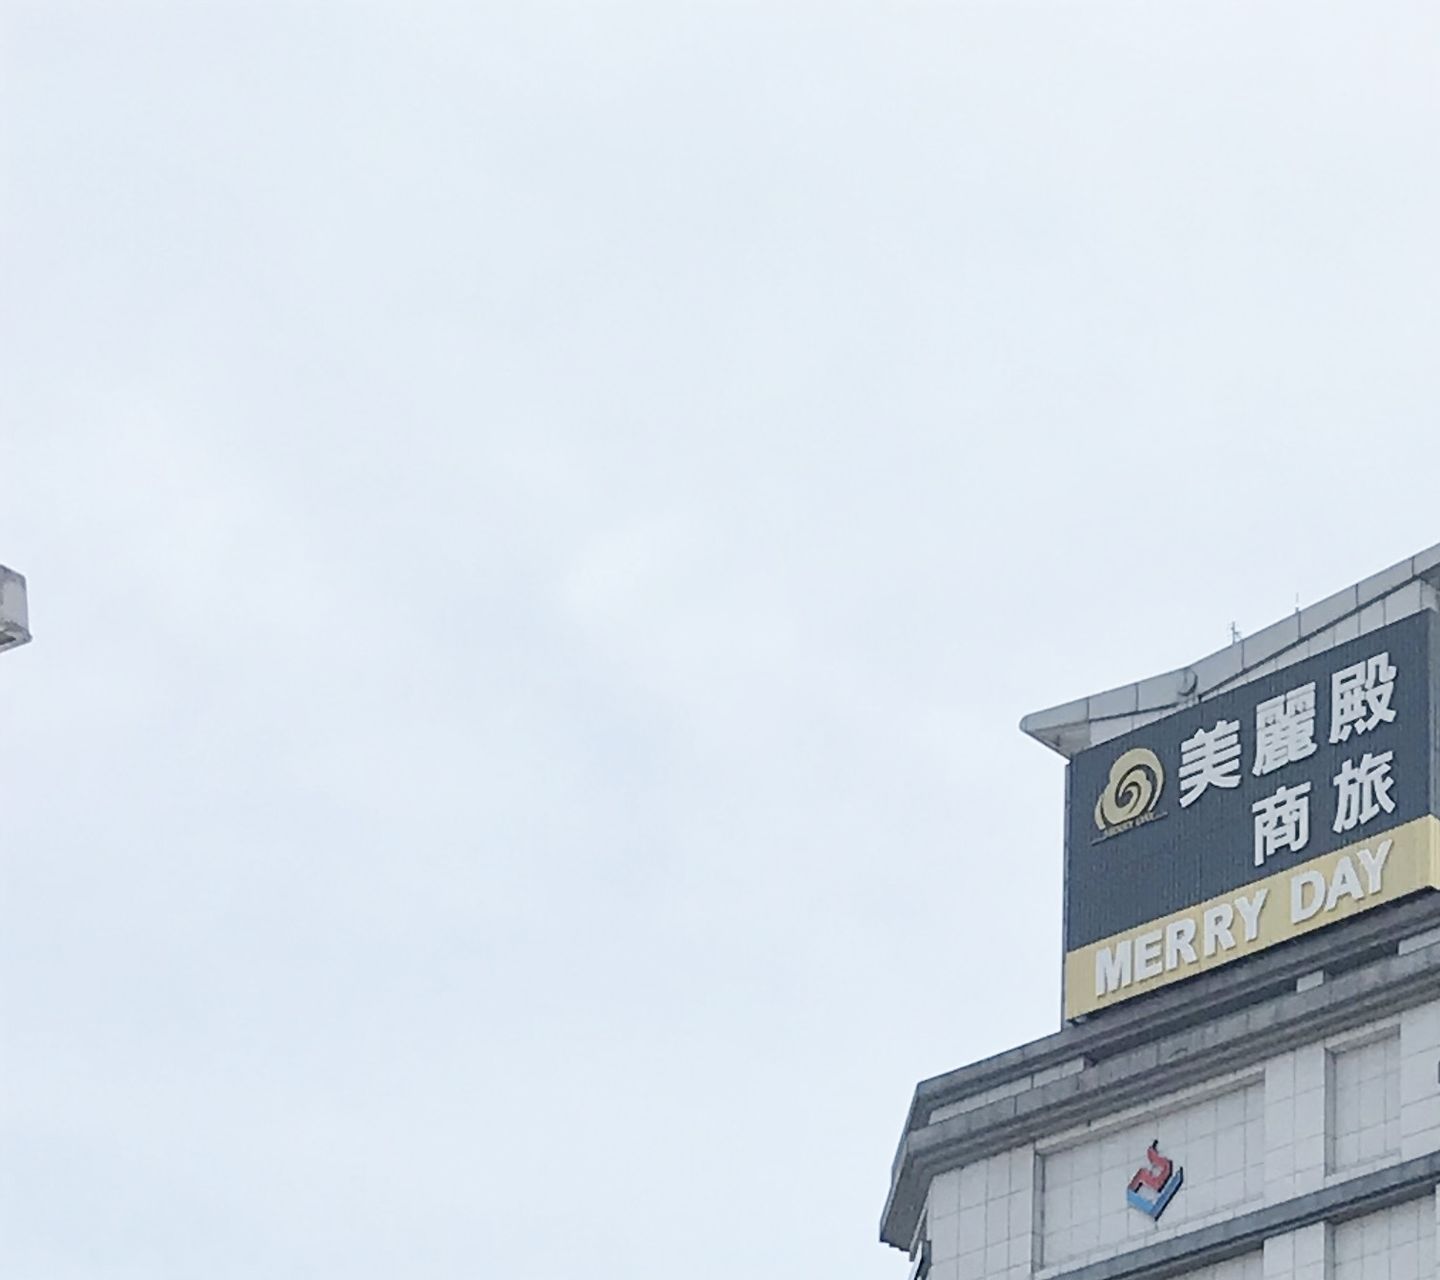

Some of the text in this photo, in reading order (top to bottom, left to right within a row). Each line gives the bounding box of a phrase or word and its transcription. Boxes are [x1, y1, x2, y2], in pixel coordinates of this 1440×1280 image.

[1179, 652, 1396, 806] 美麗殿
[1253, 749, 1395, 865] 商旅
[1096, 839, 1393, 998] MERRY DAY
